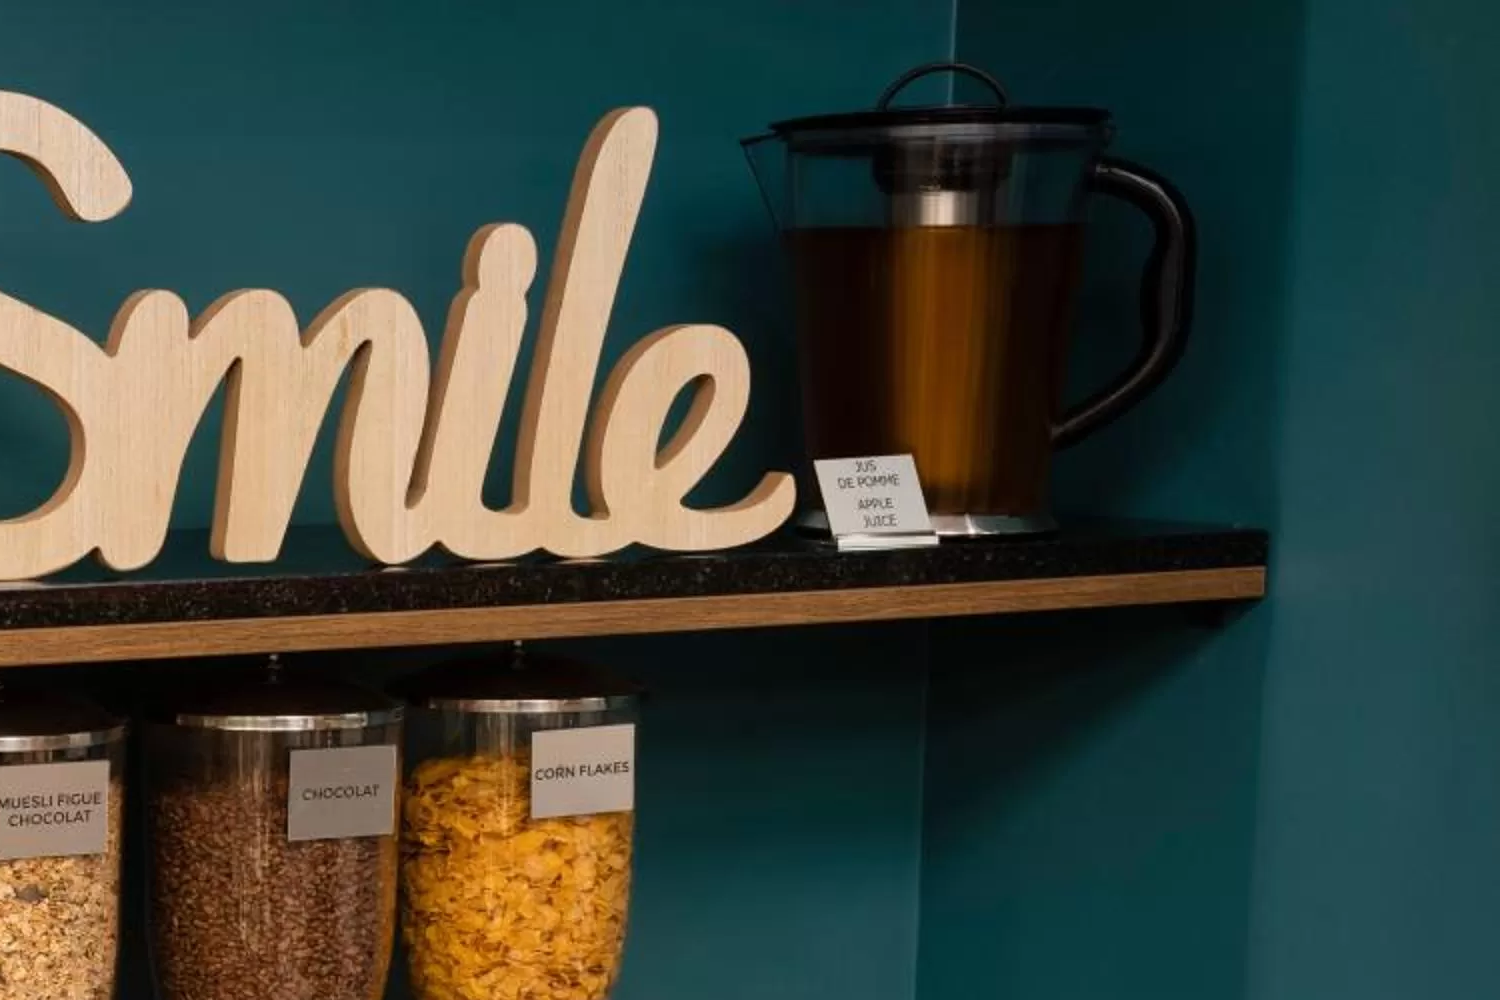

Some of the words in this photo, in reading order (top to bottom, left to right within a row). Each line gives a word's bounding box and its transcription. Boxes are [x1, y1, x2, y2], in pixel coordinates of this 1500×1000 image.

[855, 459, 877, 473] JUS
[837, 477, 855, 489] DE
[857, 473, 900, 488] POMME
[858, 497, 894, 510] APPLE
[864, 514, 898, 528] JUICE
[535, 766, 575, 781] CORN
[579, 761, 630, 777] FLAKES
[57, 791, 102, 807] FIGUE
[302, 783, 380, 801] CHOCOLAT
[7, 809, 92, 827] CHOCOLAT
